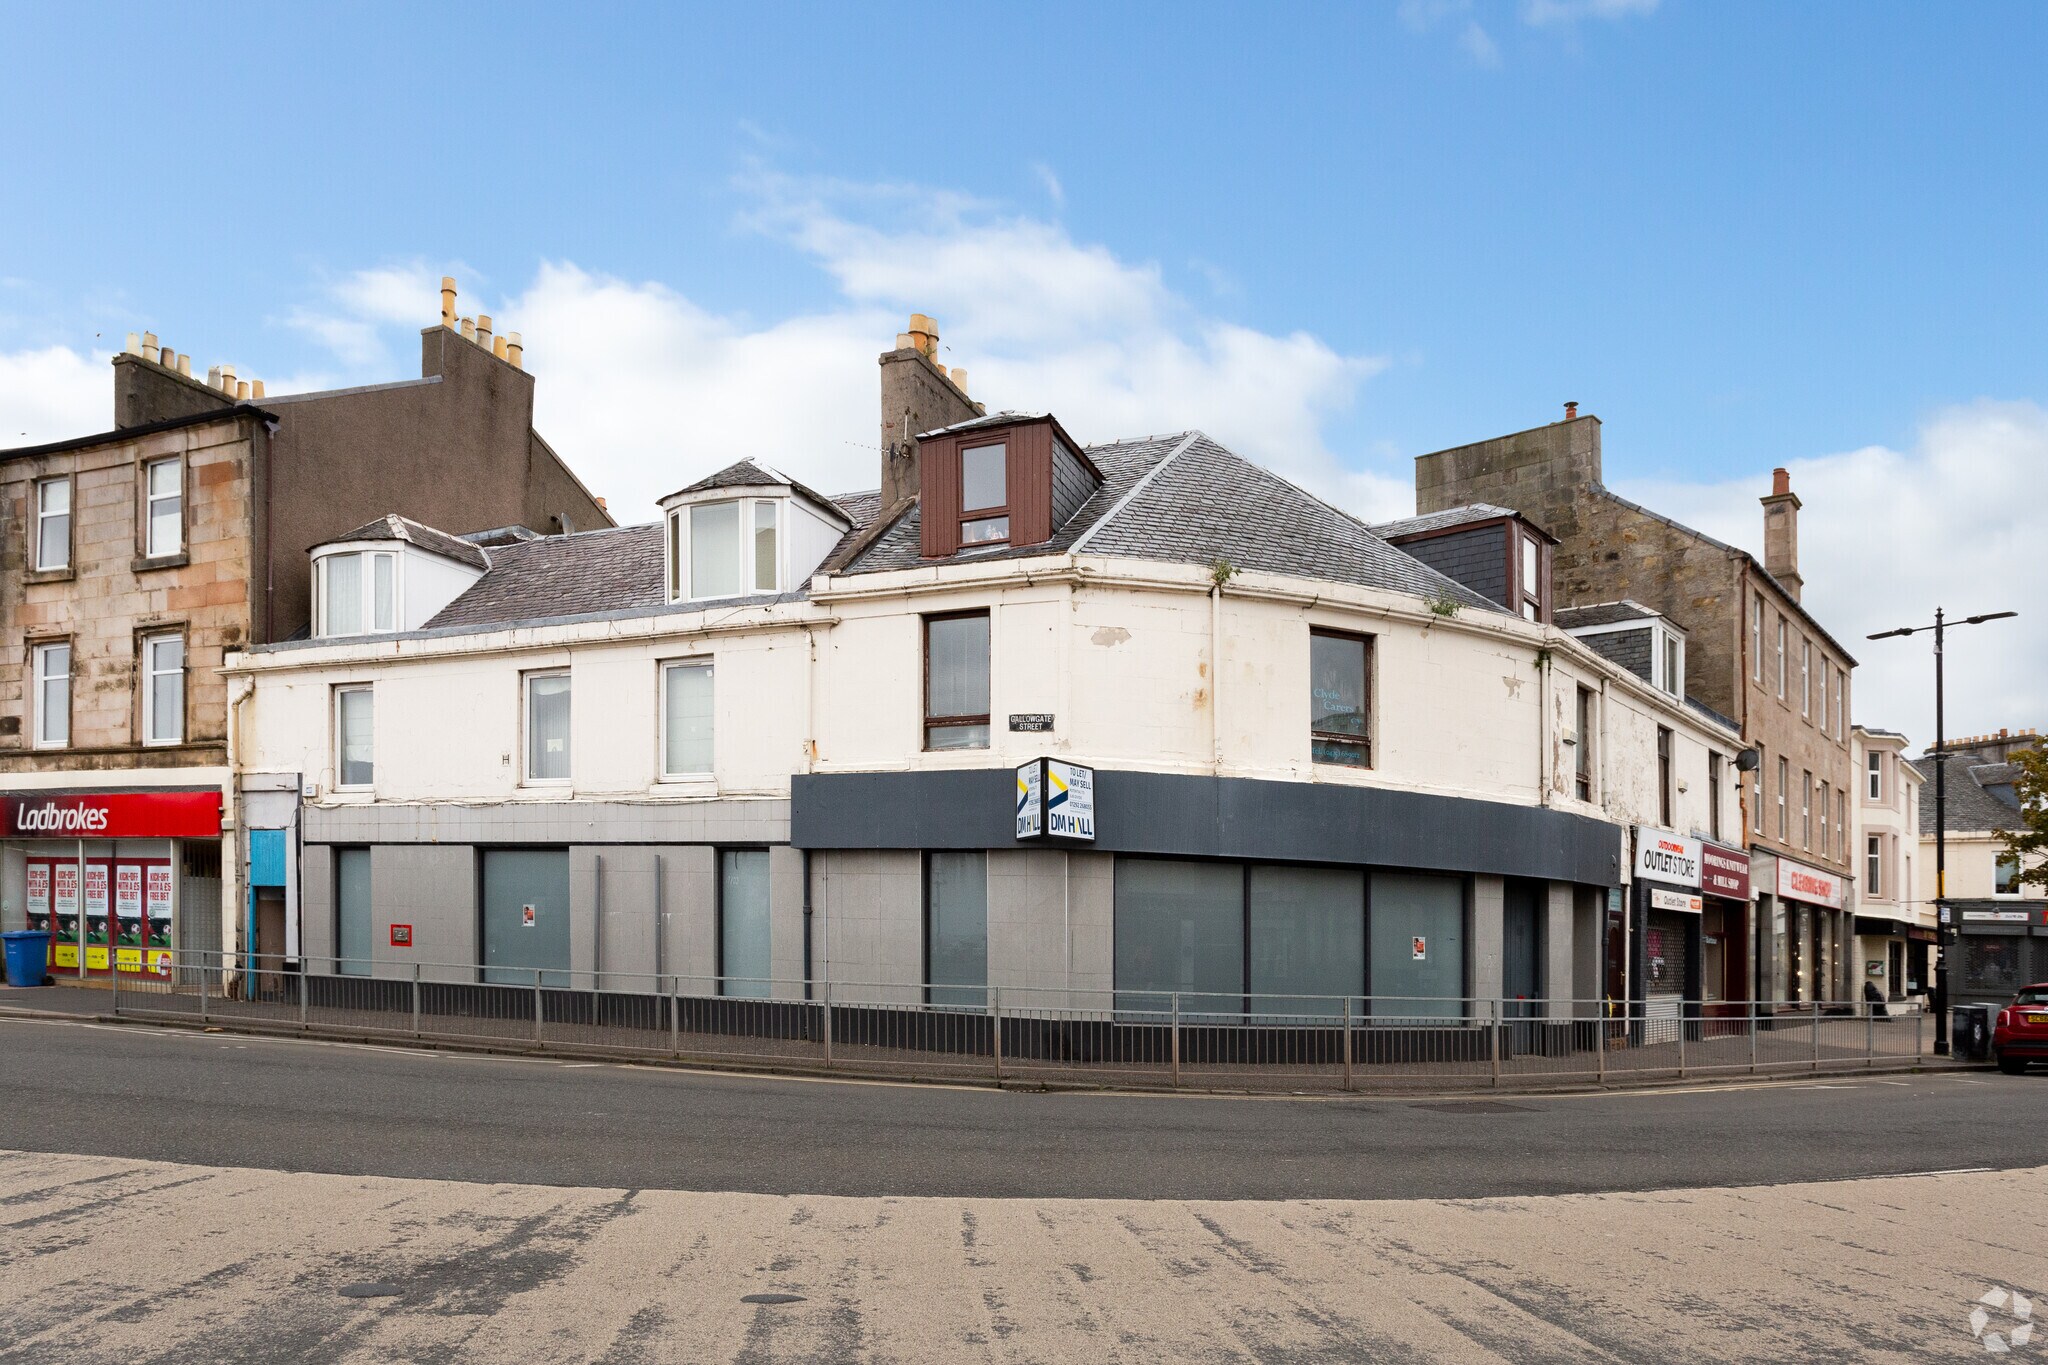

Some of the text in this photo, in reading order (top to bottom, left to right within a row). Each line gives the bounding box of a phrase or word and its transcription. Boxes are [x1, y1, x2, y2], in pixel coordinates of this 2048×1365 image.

[1313, 688, 1340, 700] Clyde
[1324, 700, 1354, 713] Carers
[1010, 715, 1052, 723] GALLOWGATE
[1019, 723, 1043, 731] STREET
[1070, 767, 1077, 776] TO
[1070, 778, 1092, 790] MAY SELL
[17, 801, 109, 830] Ladbrokes
[1018, 816, 1026, 834] DM
[1051, 813, 1092, 835] DM HALL
[1644, 849, 1695, 878] OUTLET STORE
[38, 889, 46, 897] BET
[67, 889, 75, 897] BET
[97, 890, 105, 899] BET
[129, 891, 138, 900] BET
[160, 892, 169, 901] BET
[1664, 895, 1677, 907] Outlet
[1677, 897, 1686, 908] Store
